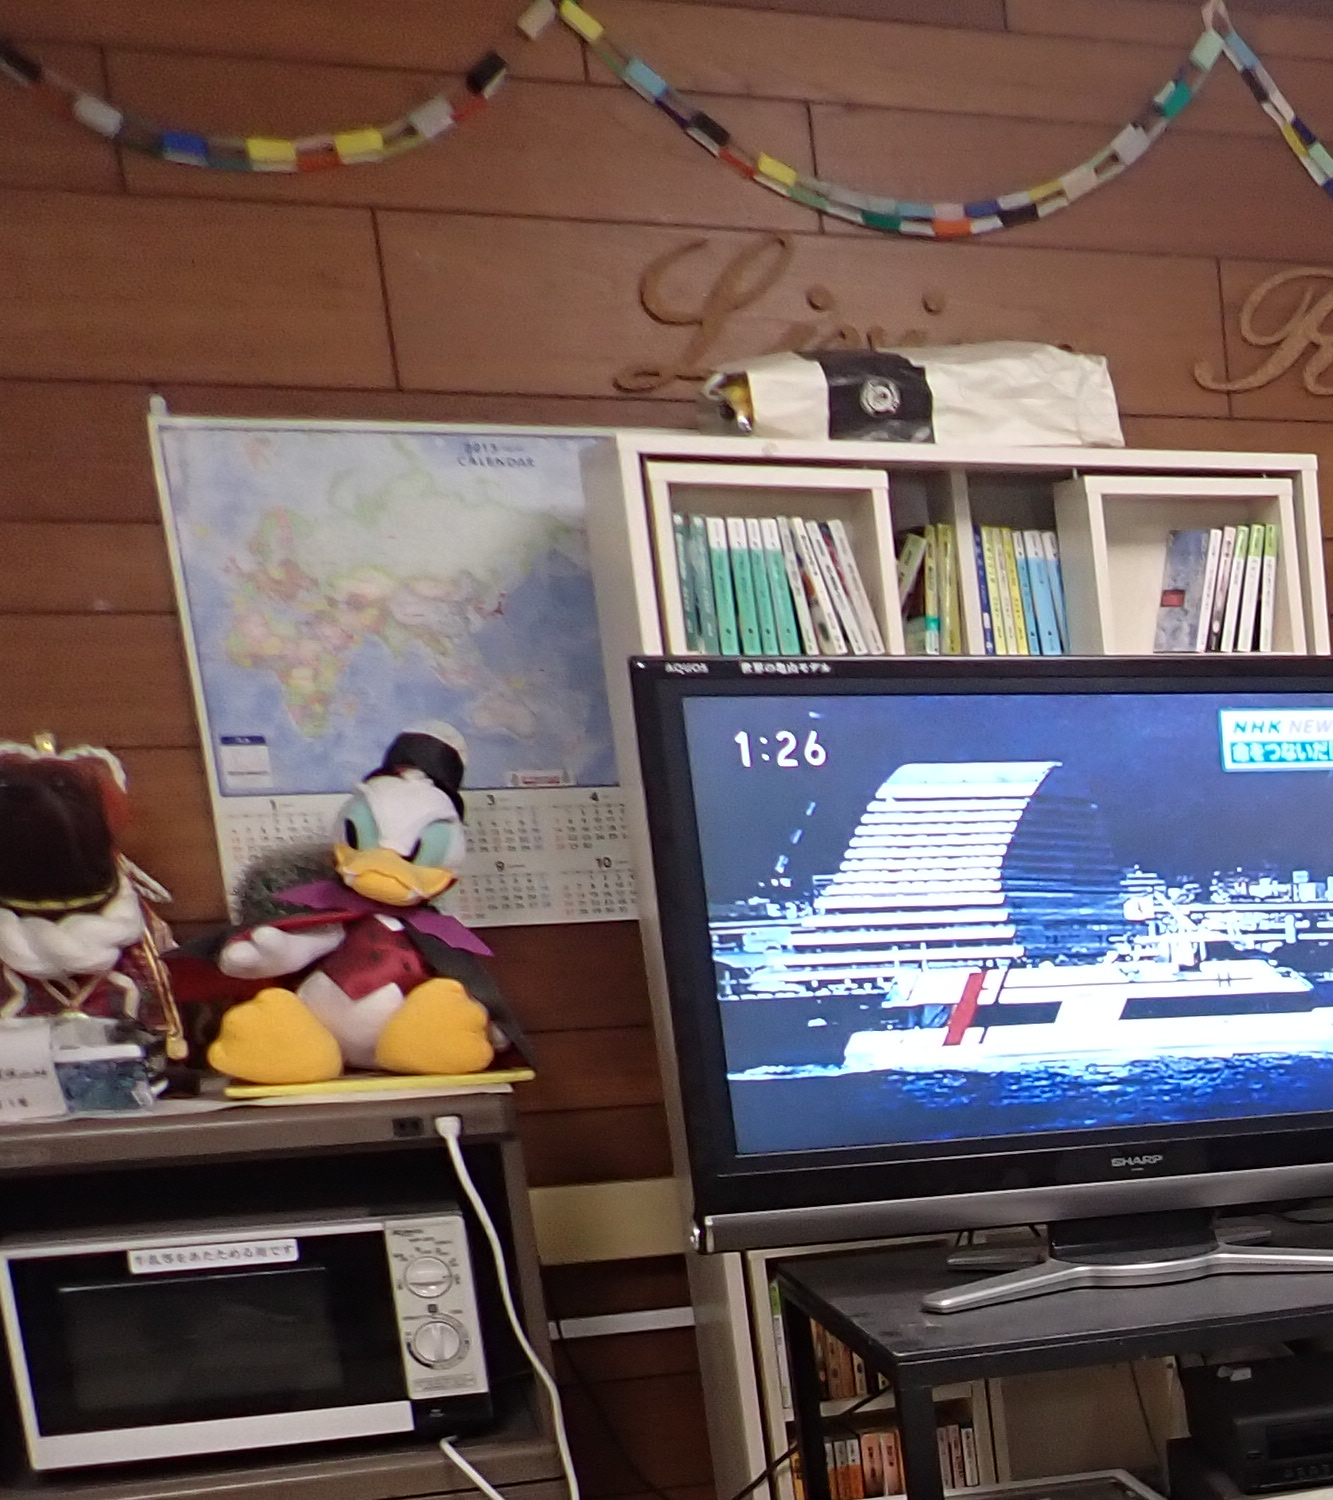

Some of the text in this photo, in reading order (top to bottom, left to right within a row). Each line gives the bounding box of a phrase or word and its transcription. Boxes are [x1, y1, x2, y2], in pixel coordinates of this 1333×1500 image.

[1233, 719, 1282, 735] NHK
[734, 730, 827, 768] 1:26
[1111, 1154, 1164, 1167] SHARP
